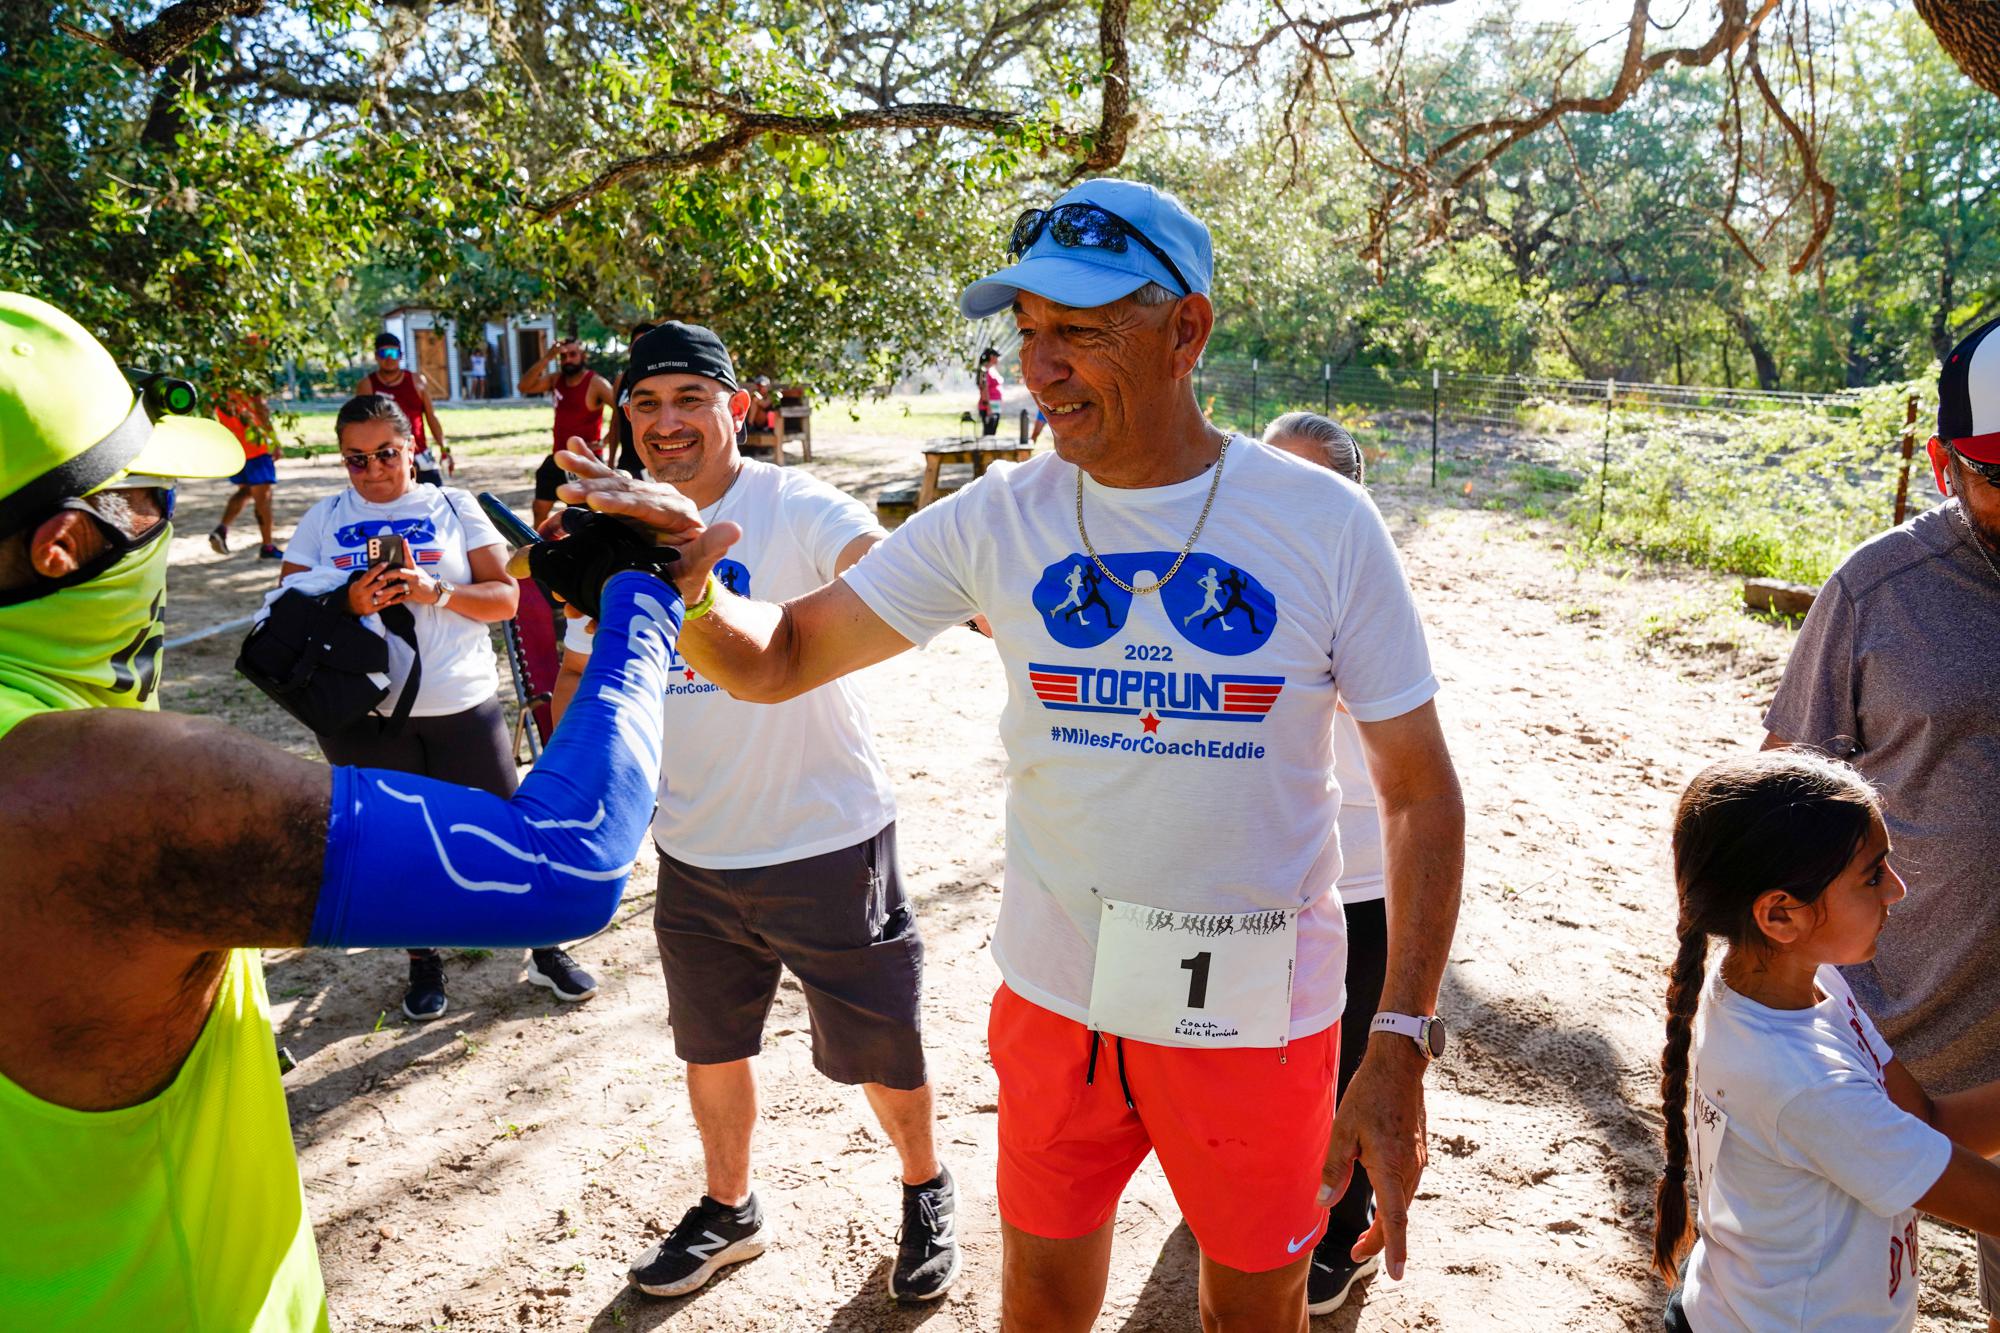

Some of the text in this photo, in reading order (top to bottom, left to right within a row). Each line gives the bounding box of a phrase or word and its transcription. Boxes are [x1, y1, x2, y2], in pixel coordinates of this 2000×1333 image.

[1124, 645, 1173, 662] 2022
[1073, 666, 1221, 712] TOPRUN
[1051, 726, 1265, 759] #MilesForCoachEddie
[1180, 951, 1211, 1009] 1
[1174, 1027, 1202, 1037] Eddie
[1180, 1018, 1218, 1028] Coach
